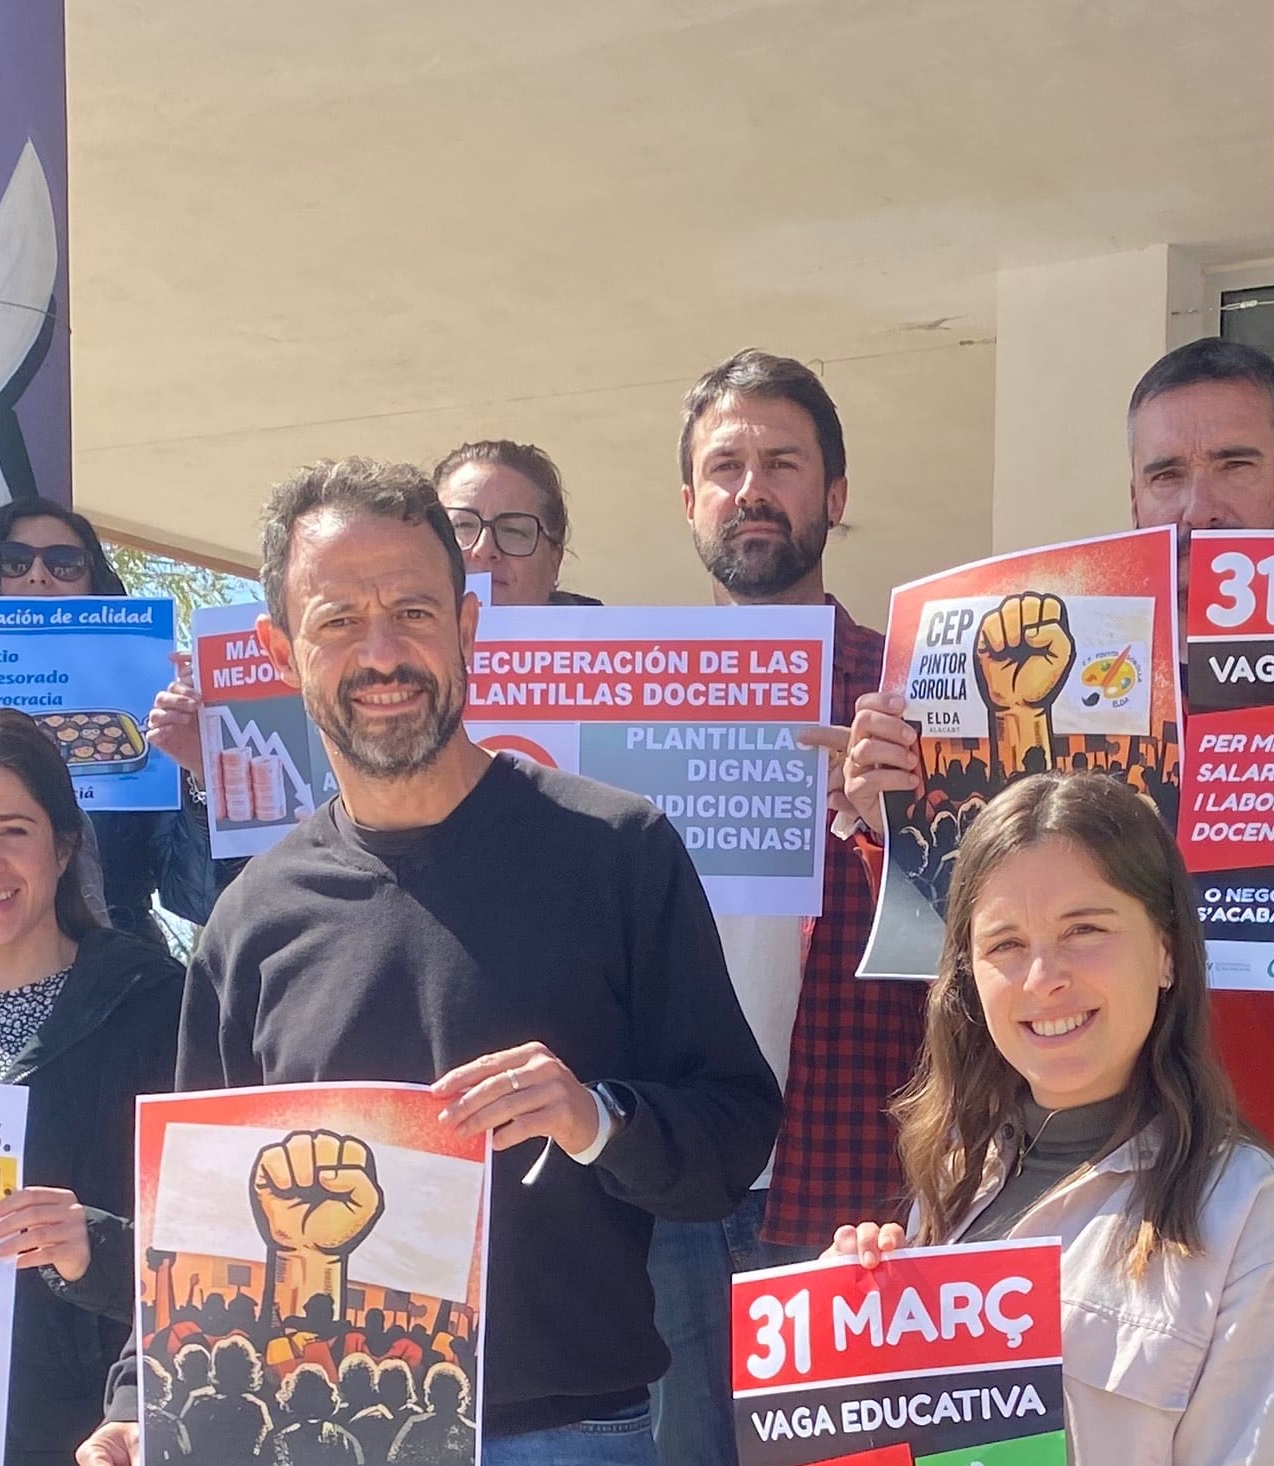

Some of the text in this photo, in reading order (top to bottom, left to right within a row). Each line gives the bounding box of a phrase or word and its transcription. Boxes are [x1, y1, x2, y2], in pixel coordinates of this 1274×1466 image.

[50, 608, 72, 624] de
[79, 606, 153, 624] calidad
[926, 609, 974, 647] CEP
[468, 646, 808, 675] ECUPERACIÓN DE LAS
[919, 652, 967, 675] PINTOR
[468, 683, 809, 707] LANTILLAS DOCENTES
[910, 678, 967, 701] SOROLLA
[927, 712, 960, 725] ELDA
[1199, 734, 1247, 753] PER
[687, 759, 813, 788] DIGNAS,
[1194, 793, 1201, 811] I
[686, 827, 811, 850] DIGNAS!
[1205, 888, 1221, 903] O
[747, 1276, 1034, 1380] 31 MARÇ
[751, 1384, 1046, 1442] VAGA EDUCATIVA
